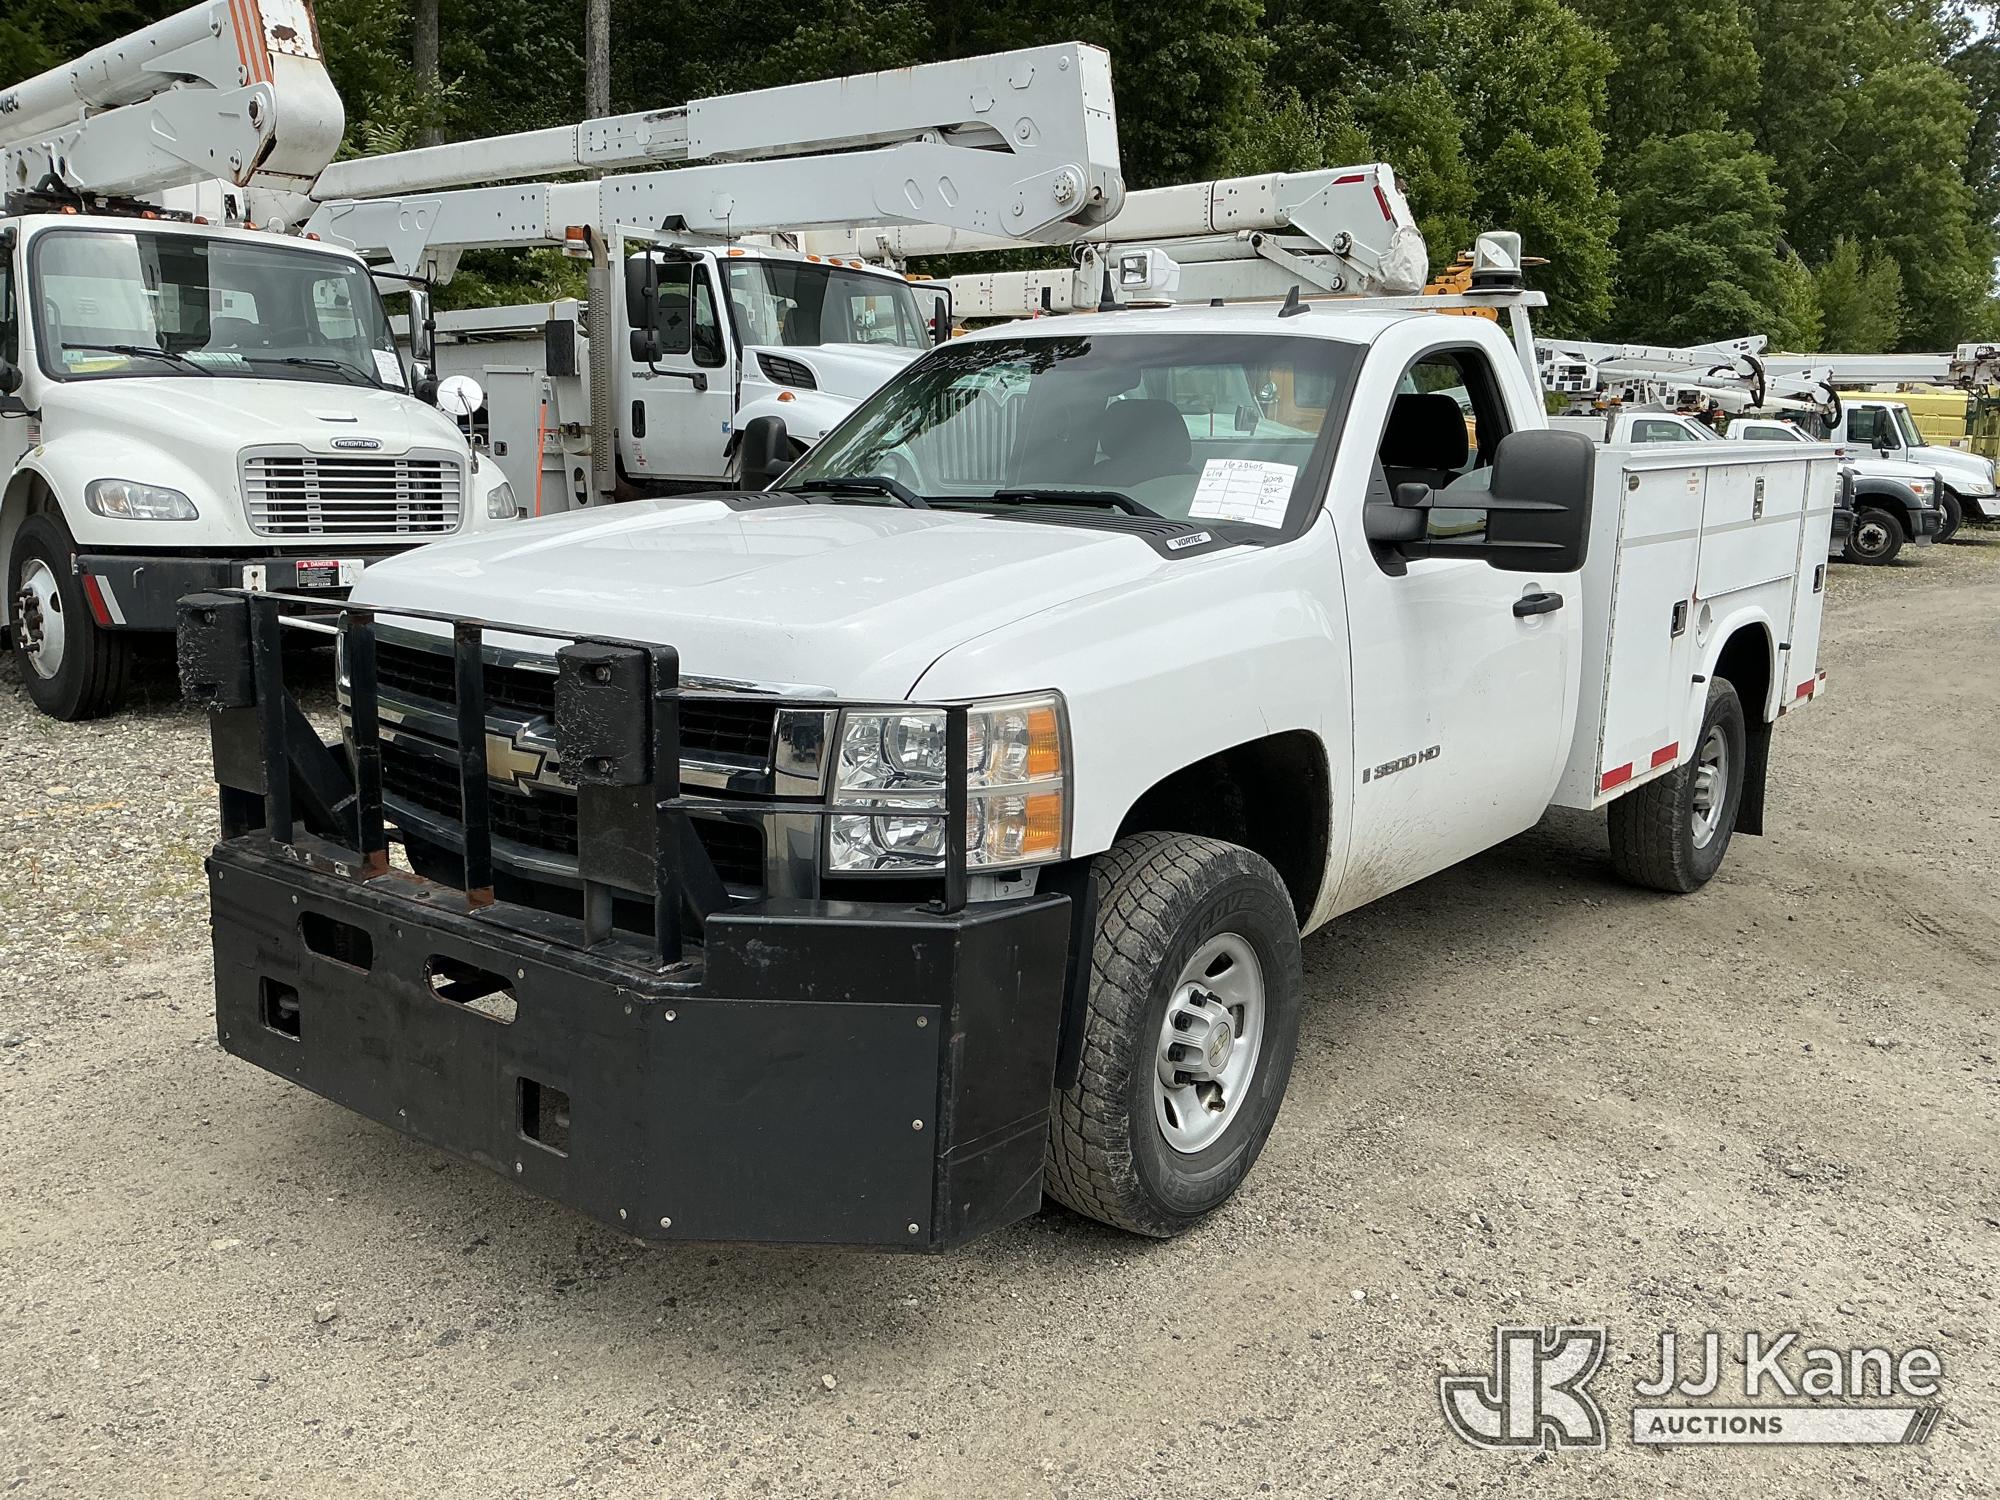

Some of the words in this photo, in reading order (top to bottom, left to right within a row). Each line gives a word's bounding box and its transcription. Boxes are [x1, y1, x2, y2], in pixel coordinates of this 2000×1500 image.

[336, 440, 378, 448] FREIGHTLINER
[1174, 534, 1203, 547] VORTEC
[1373, 753, 1417, 780] 3500
[1418, 744, 1441, 764] HD
